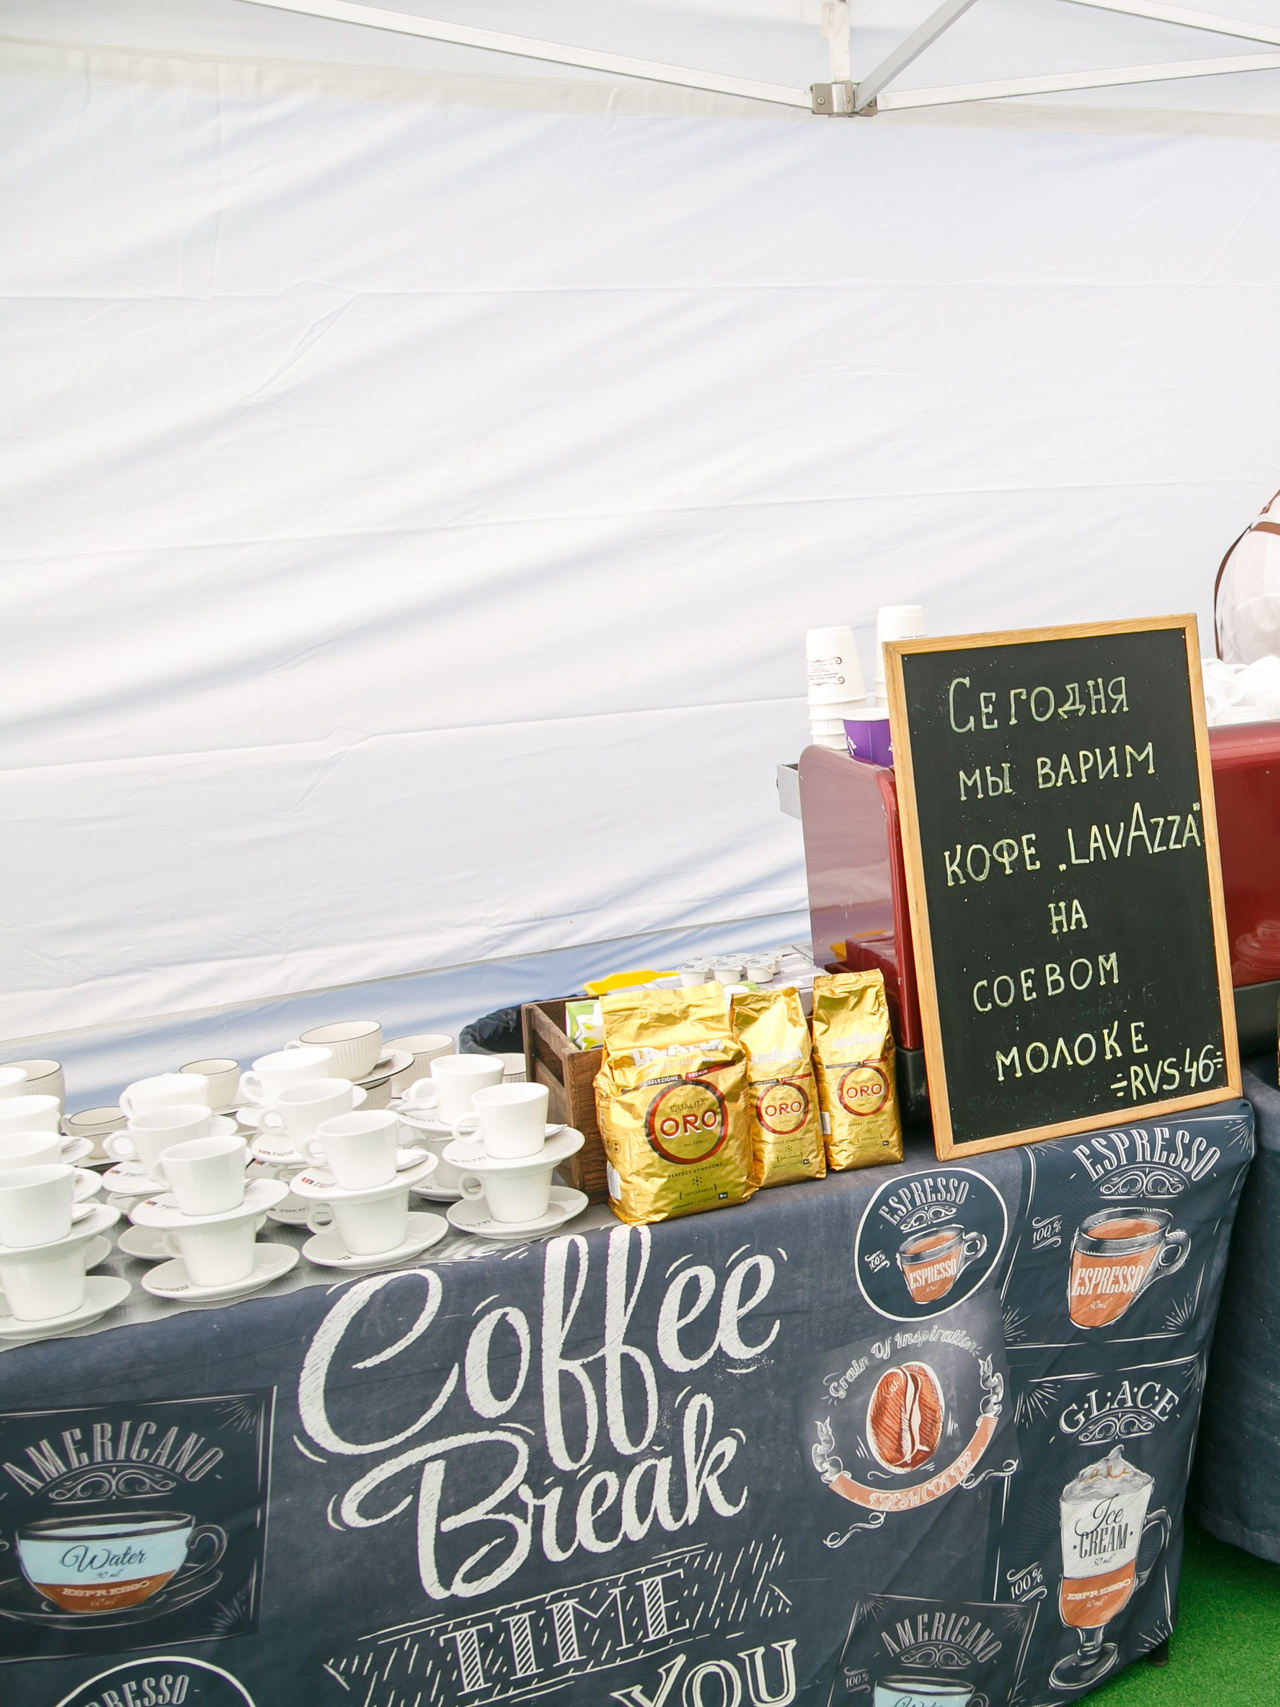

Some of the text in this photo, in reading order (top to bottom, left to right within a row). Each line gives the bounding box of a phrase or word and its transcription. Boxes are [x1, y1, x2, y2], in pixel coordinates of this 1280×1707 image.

[1037, 742, 1155, 789] ВАРИМ
[944, 833, 1040, 886] КОФЕ
[1048, 899, 1088, 933] НА
[973, 952, 1119, 1012] СОЕВОМ
[995, 1021, 1148, 1081] МОЛОКЕ
[648, 1076, 678, 1085] SELEZIONE
[846, 1083, 883, 1100] ORO
[660, 1109, 719, 1138] ORO
[765, 1101, 803, 1118] ORO
[1073, 1127, 1221, 1182] ESPRESSO
[668, 1170, 692, 1178] PERFECT
[878, 1177, 970, 1226] ESPRESSO
[1032, 1220, 1063, 1244] 100%
[909, 1258, 958, 1290] ESPRESSO
[1071, 1265, 1144, 1297] ESPRESSO
[298, 1225, 781, 1471] Coffee
[828, 1356, 869, 1399] Grain
[894, 1325, 978, 1353] Inspiration
[2, 1420, 224, 1496] AMERICANO
[341, 1393, 747, 1600] Break
[1075, 1493, 1124, 1536] Ice
[61, 1544, 147, 1573] Water
[61, 1579, 151, 1597] ESPRESSO
[1011, 1567, 1044, 1599] 100%
[1067, 1578, 1131, 1600] ESPRESSO
[439, 1569, 691, 1697] TIME
[881, 1612, 1002, 1663] AMERICANO
[610, 1639, 797, 1707] YOU
[845, 1673, 870, 1688] 100%
